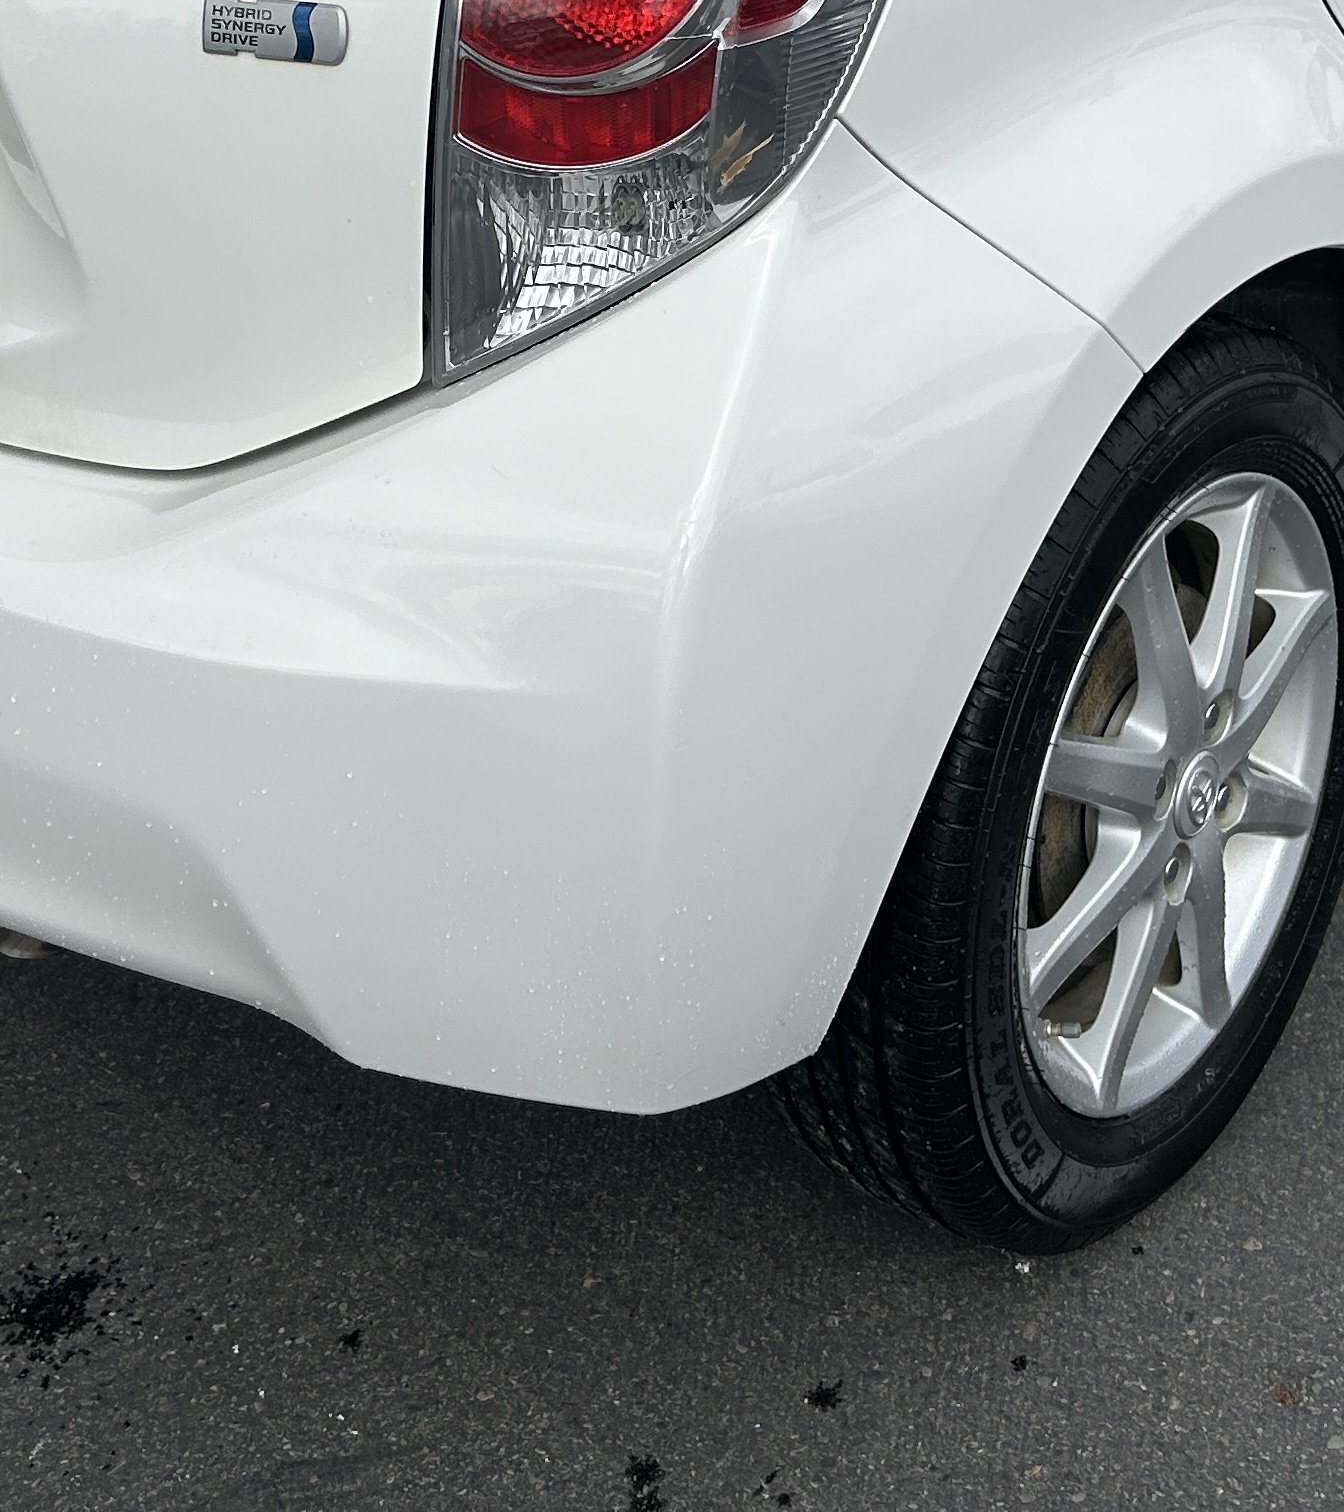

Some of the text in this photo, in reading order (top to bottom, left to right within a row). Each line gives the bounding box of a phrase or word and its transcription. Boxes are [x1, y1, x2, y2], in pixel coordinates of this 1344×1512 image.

[212, 4, 272, 21] HYBRID
[211, 18, 287, 36] SYNERGY
[211, 31, 259, 47] DRIVE
[990, 1032, 1046, 1171] DORAL
